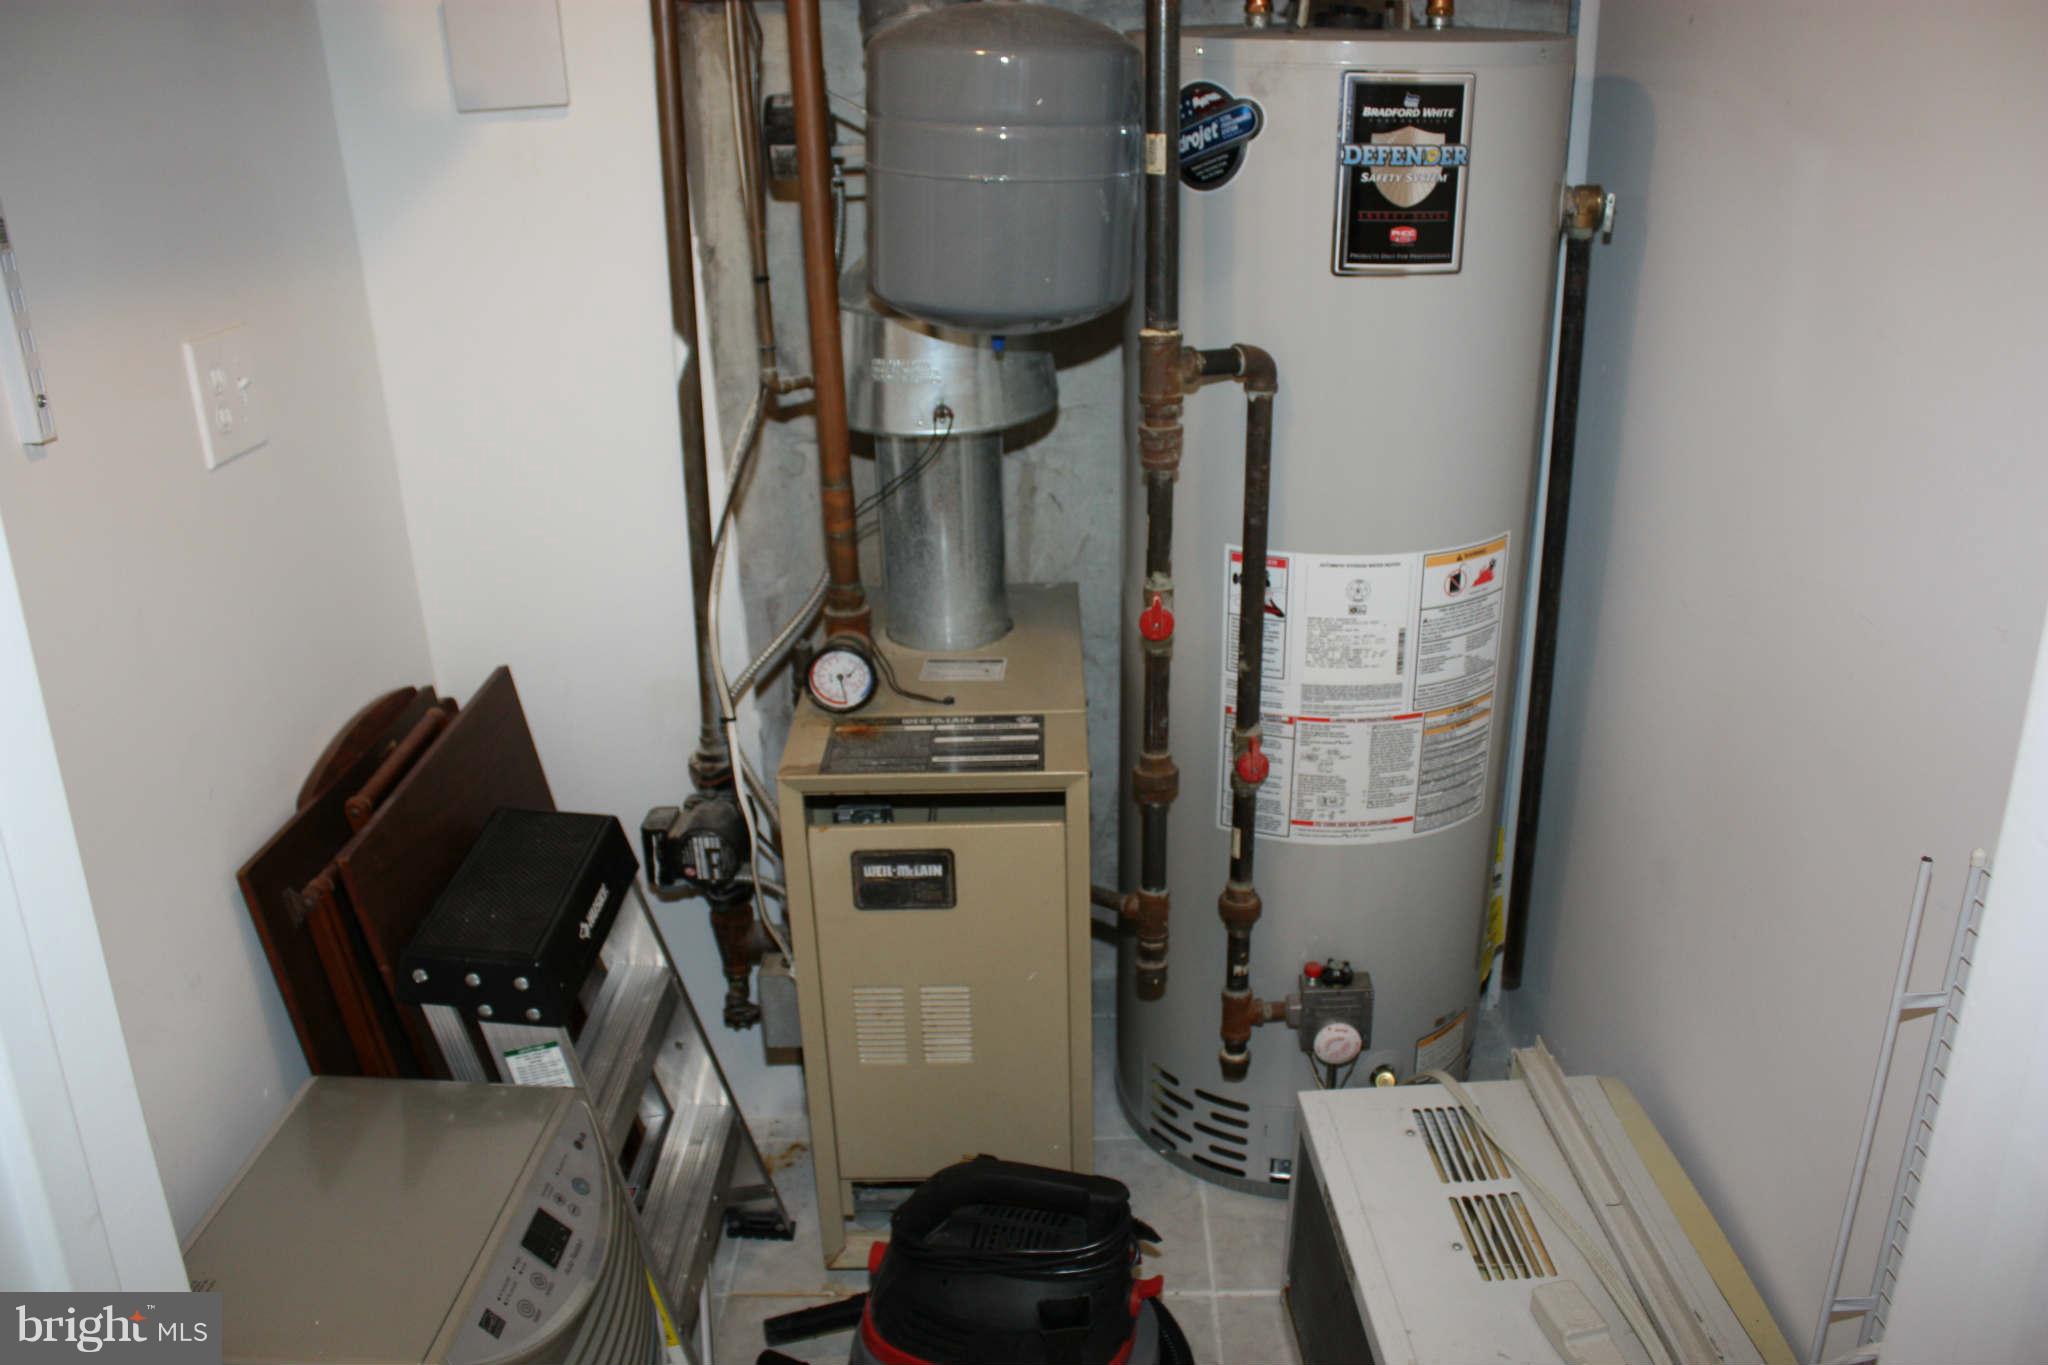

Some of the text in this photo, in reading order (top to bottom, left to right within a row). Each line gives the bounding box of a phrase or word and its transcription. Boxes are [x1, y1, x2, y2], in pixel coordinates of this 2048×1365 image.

[1362, 106, 1456, 118] BRADFORD WHITE
[1342, 144, 1468, 166] DEFENDER
[1360, 172, 1448, 183] SAFETY SYSTEM
